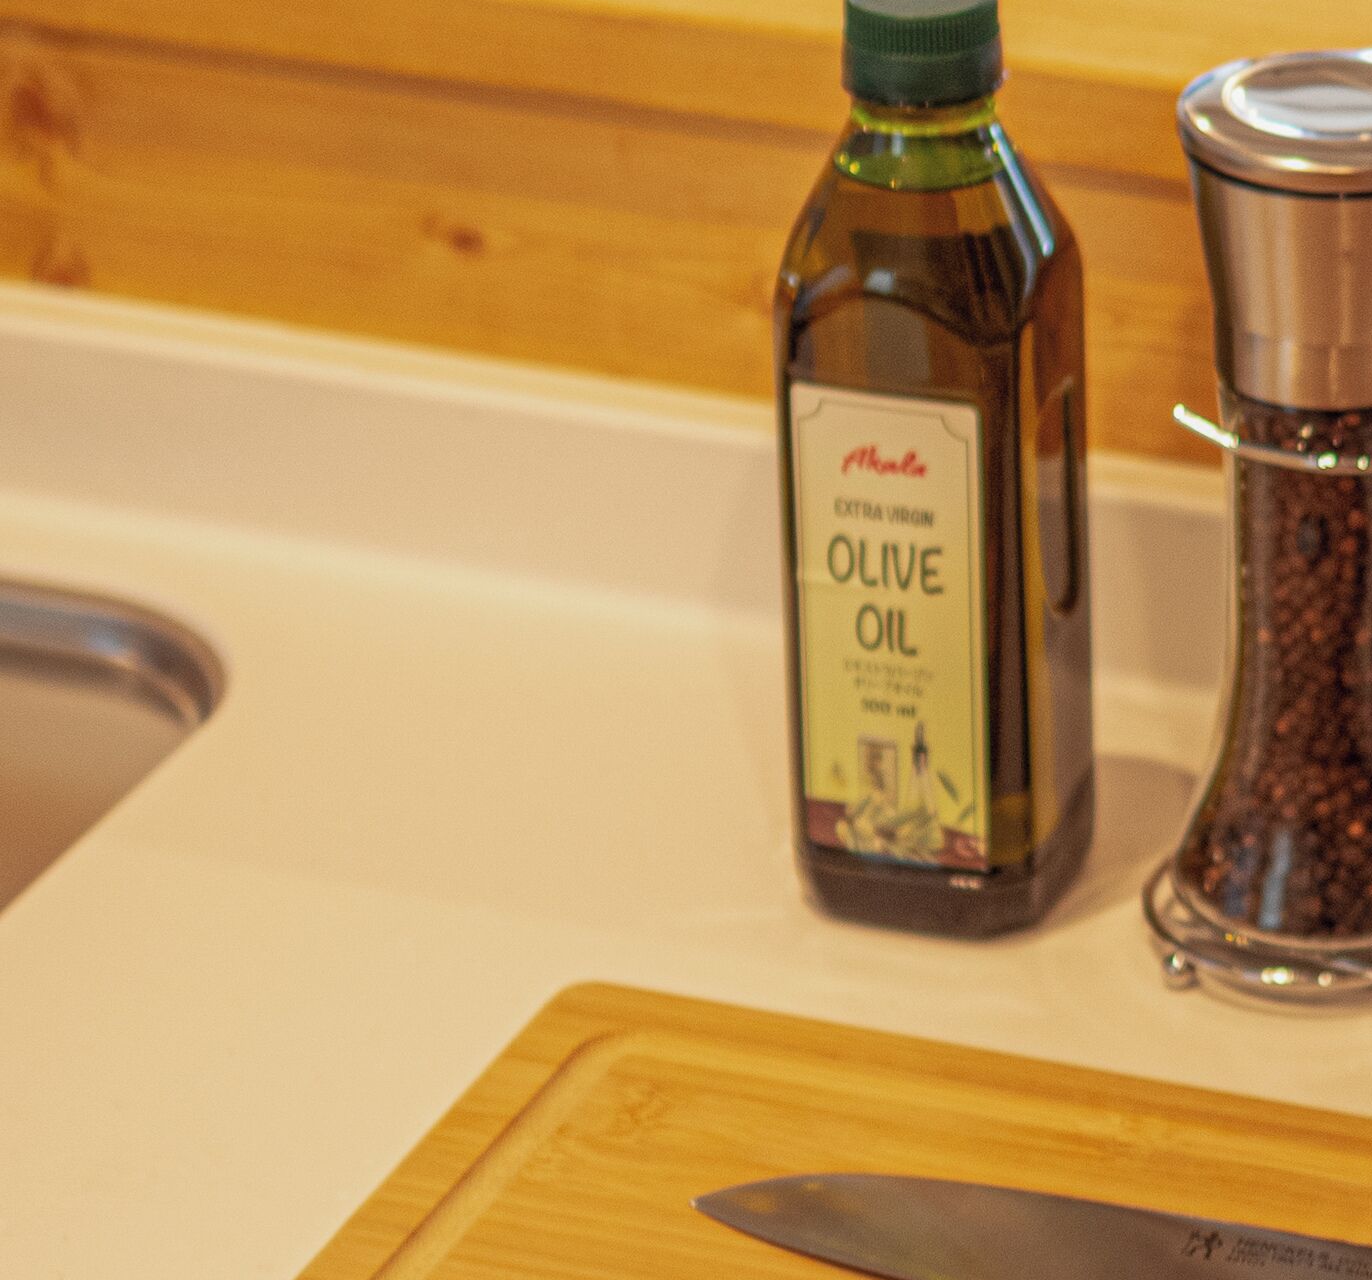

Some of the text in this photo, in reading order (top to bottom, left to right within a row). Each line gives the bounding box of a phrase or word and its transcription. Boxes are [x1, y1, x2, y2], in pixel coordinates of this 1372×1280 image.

[834, 496, 935, 527] EXTRA VIRGIN
[827, 533, 945, 596] OLIVE
[855, 602, 918, 657] OIL
